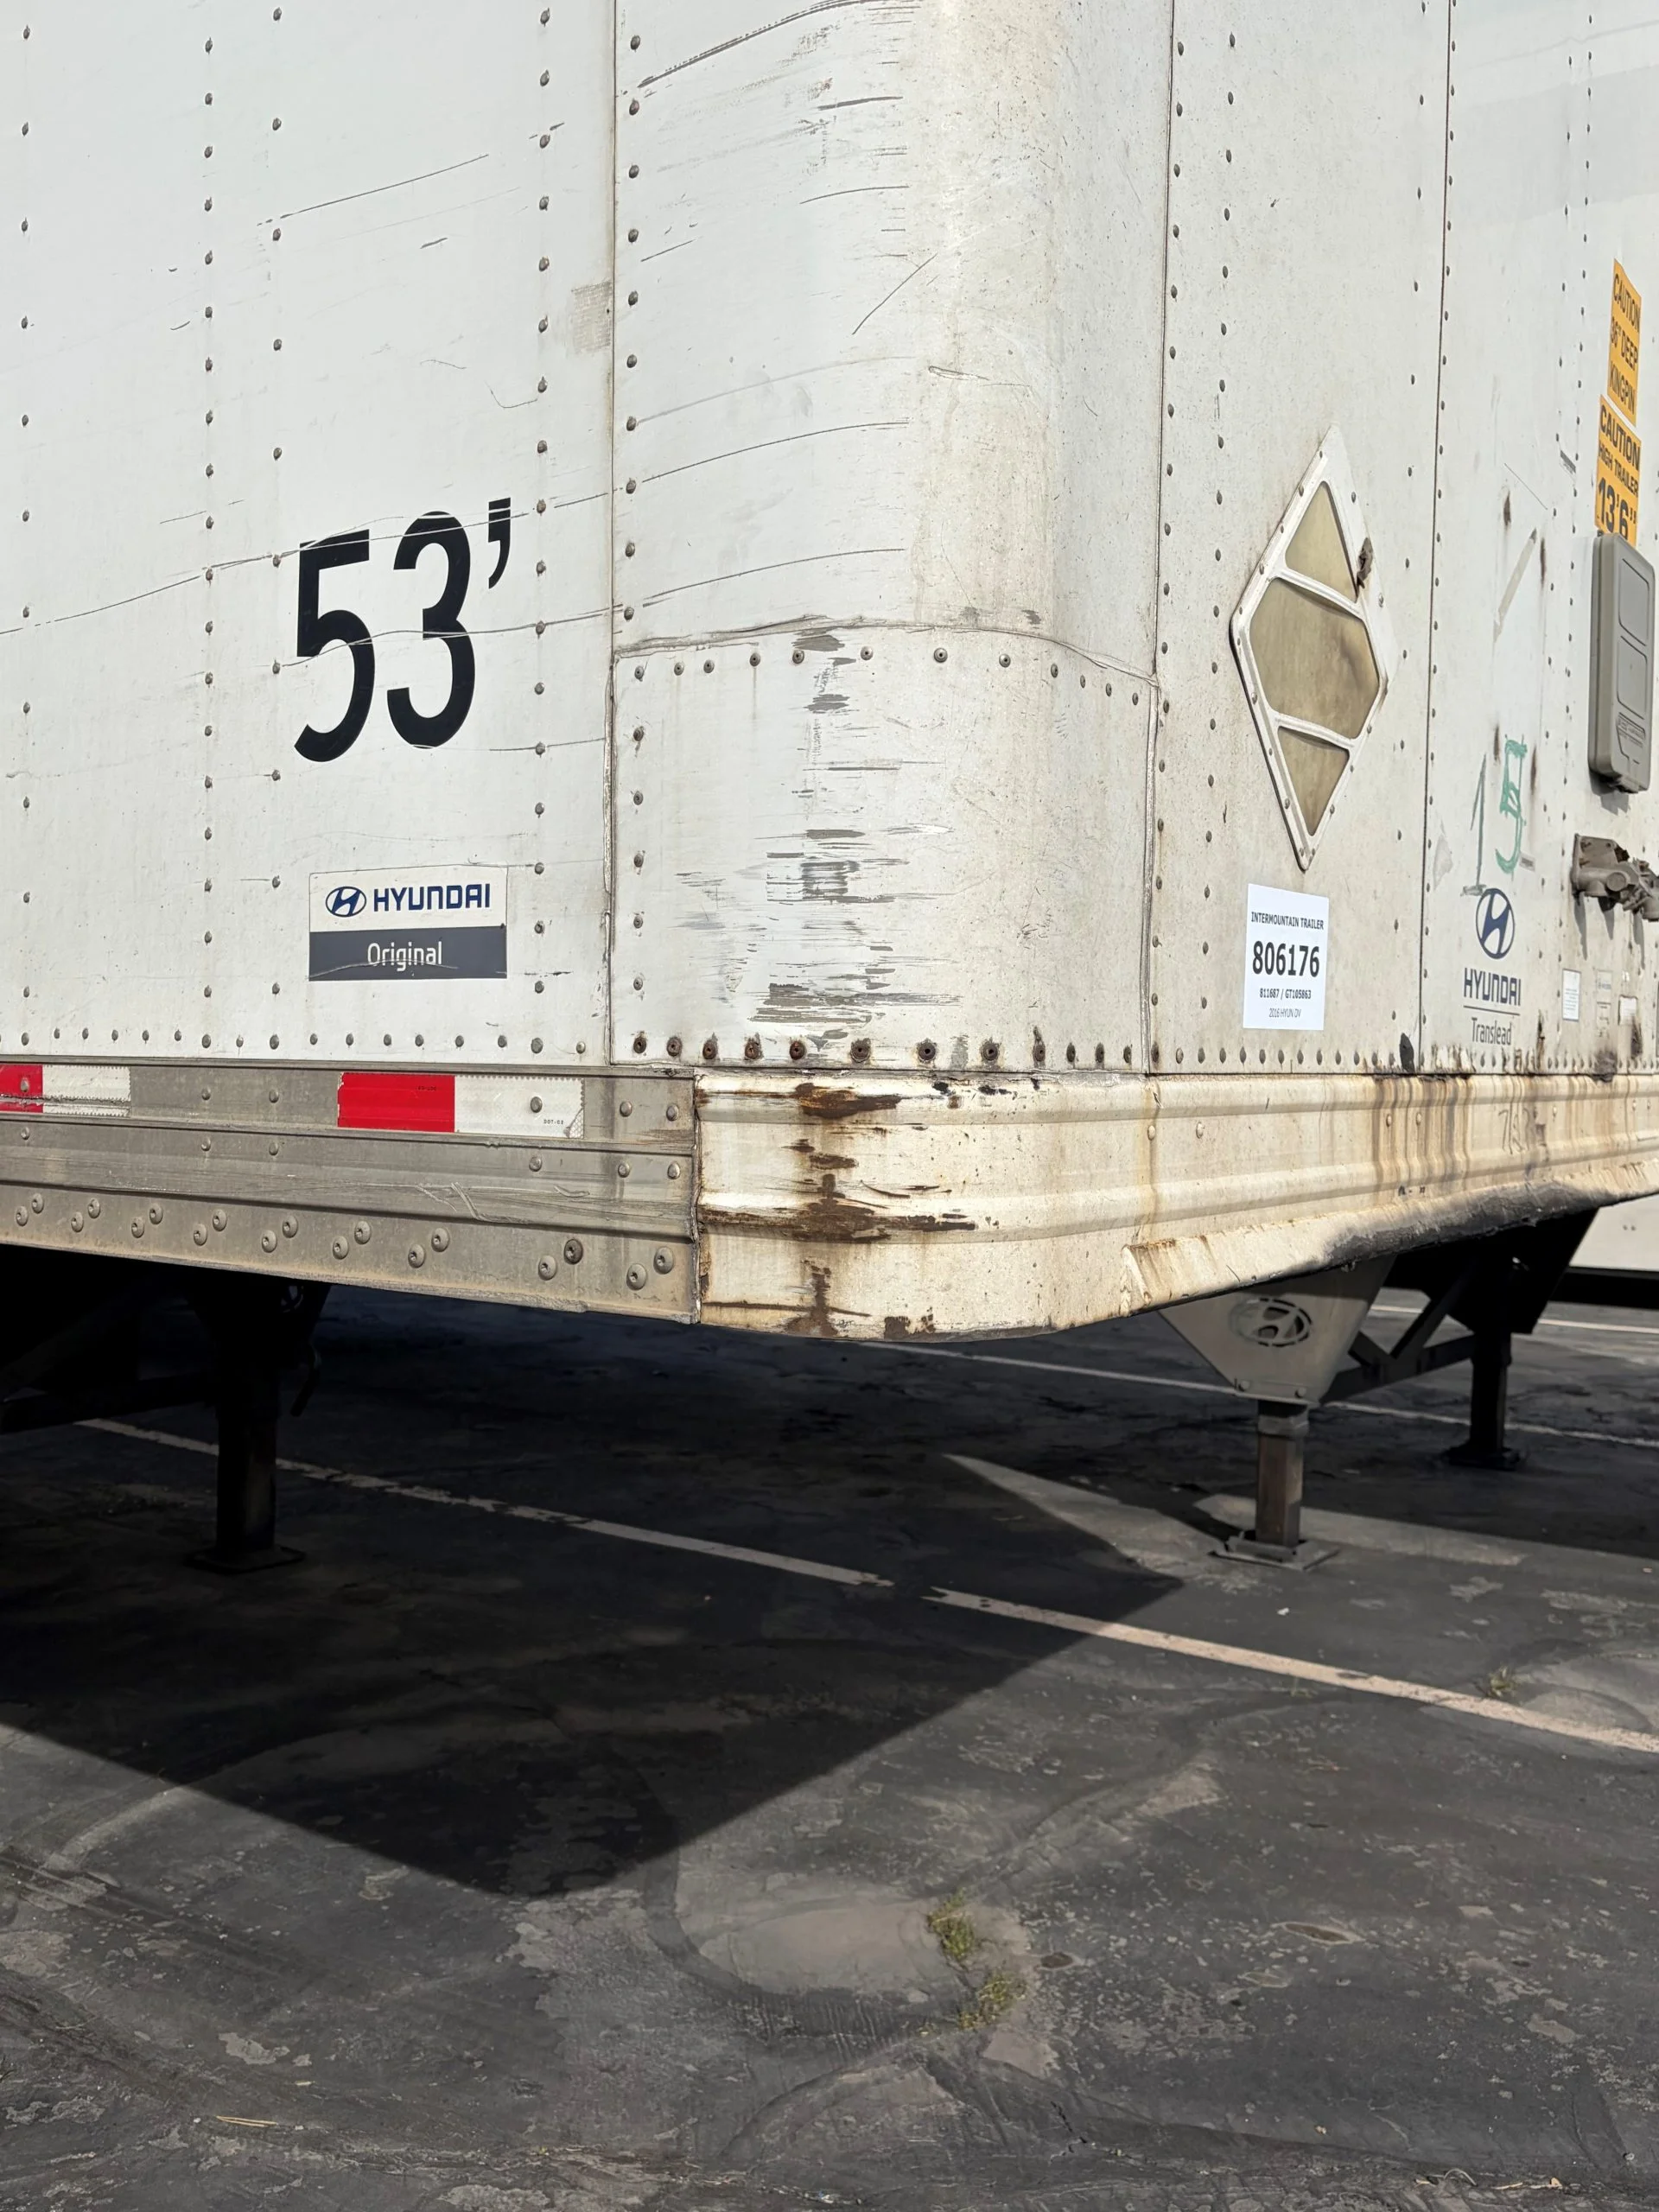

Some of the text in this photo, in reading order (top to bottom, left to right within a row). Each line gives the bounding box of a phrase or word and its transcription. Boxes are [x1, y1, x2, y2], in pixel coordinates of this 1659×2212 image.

[1613, 273, 1640, 332] CAUTION
[1621, 330, 1637, 371] DEEP
[1610, 360, 1636, 415] KINGPIN
[1600, 404, 1641, 471] CAUTION
[1599, 439, 1638, 497] HIGH TRAILER
[295, 498, 511, 762] 53'
[373, 883, 491, 912] HYUNDAI
[1251, 912, 1325, 930] INTERMOUNTAIN TRAILER
[367, 941, 443, 972] Original
[1252, 941, 1320, 977] 806176
[1464, 968, 1522, 1006] HYUNDAI
[1268, 1007, 1280, 1018] 2016
[1471, 1017, 1512, 1046] Translead
